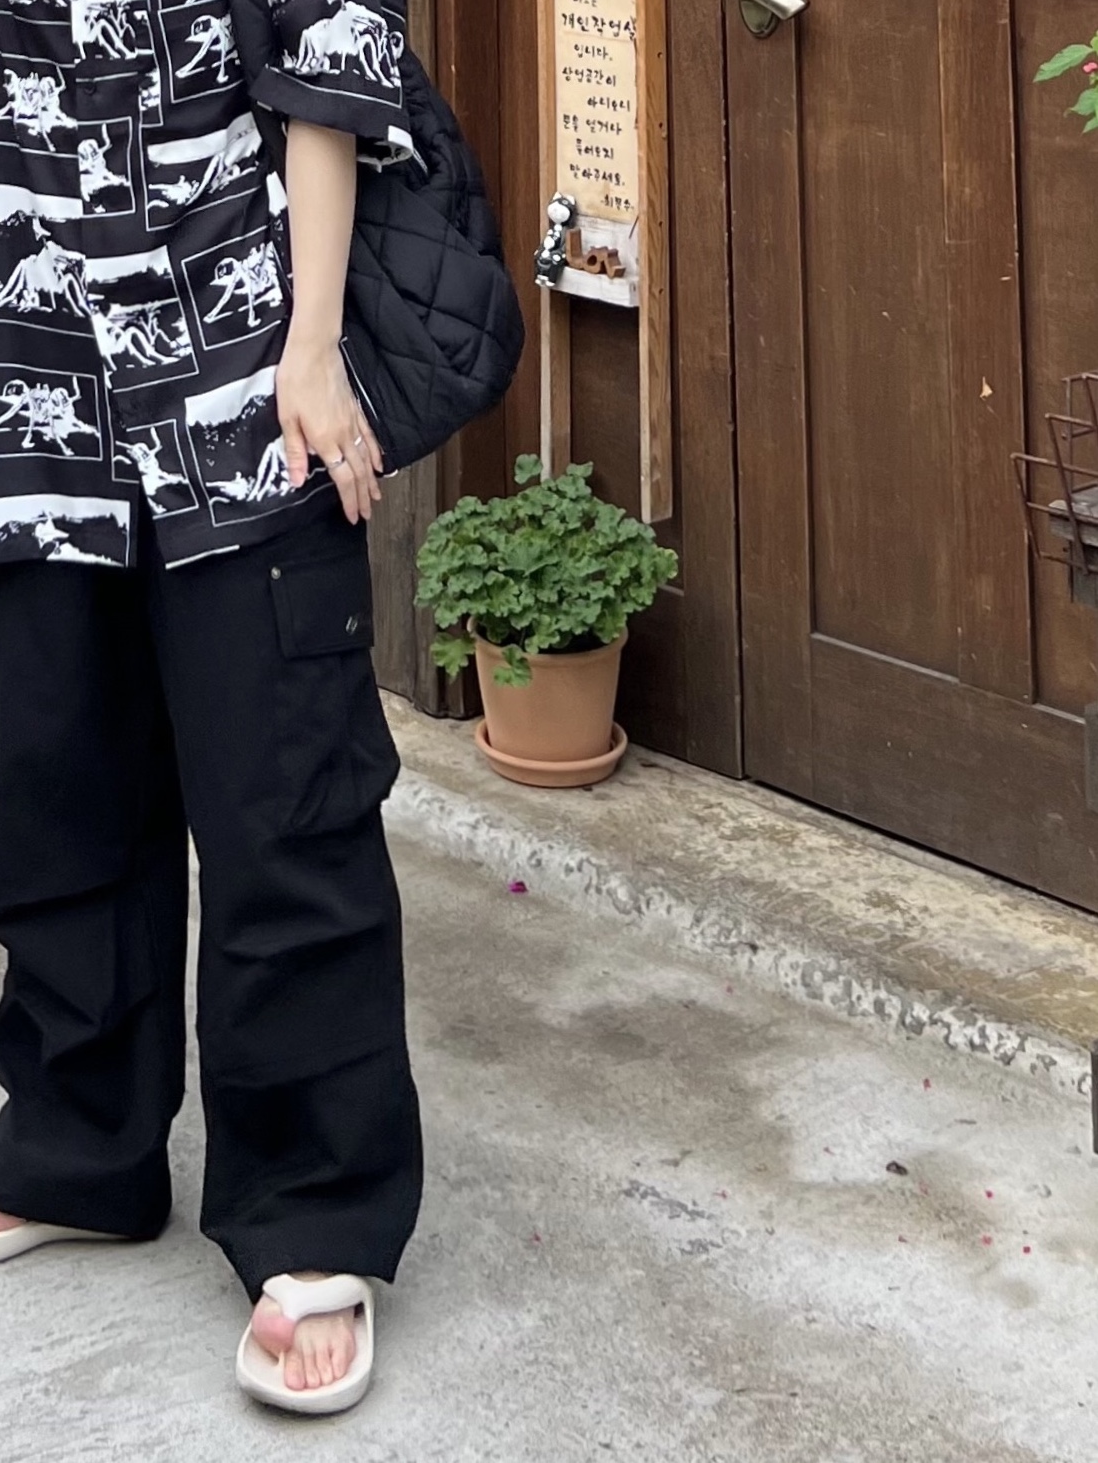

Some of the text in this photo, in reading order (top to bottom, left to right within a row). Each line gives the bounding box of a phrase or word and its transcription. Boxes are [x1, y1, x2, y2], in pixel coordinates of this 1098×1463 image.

[561, 13, 637, 41] 개인작업실
[574, 44, 613, 61] 입니다.
[562, 66, 616, 87] 상업공간이
[587, 96, 630, 112] 아니오니
[563, 113, 622, 136] 문을 열거나
[576, 138, 614, 159] 들어오지
